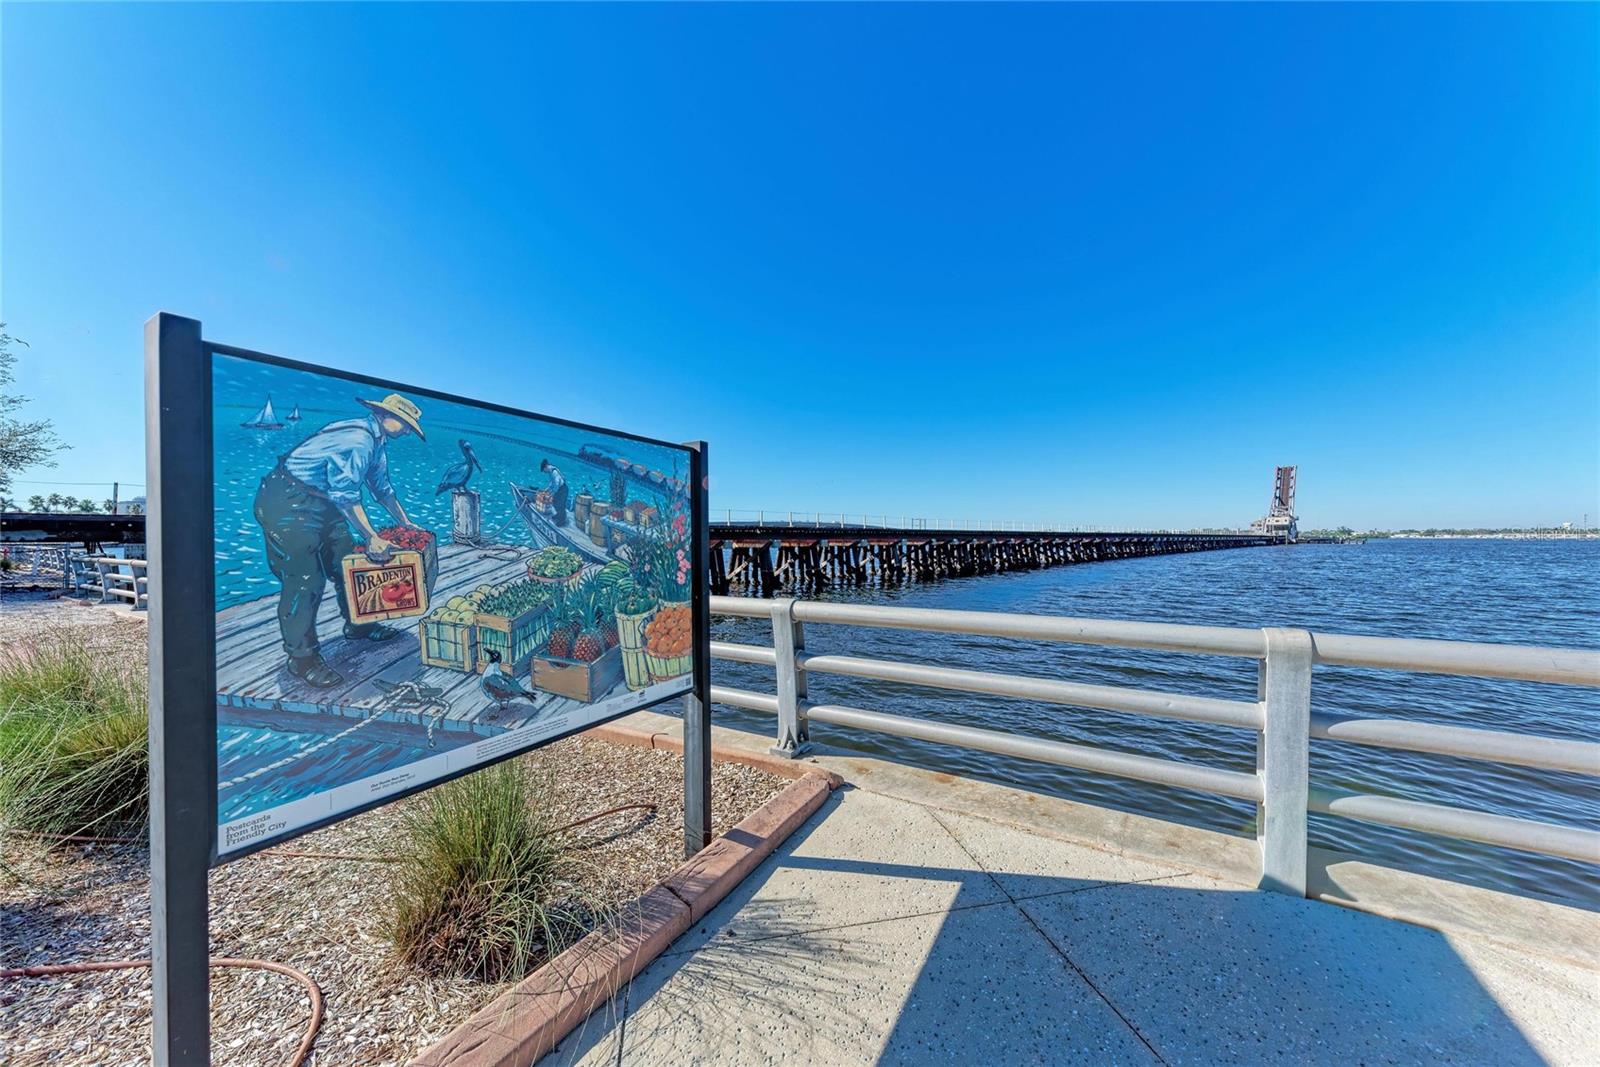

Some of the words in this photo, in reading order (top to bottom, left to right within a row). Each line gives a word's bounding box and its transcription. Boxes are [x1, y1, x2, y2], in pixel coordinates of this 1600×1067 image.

[226, 814, 271, 833] Postcards
[226, 828, 249, 840] from
[251, 822, 265, 832] the
[226, 828, 266, 846] Friendly
[268, 820, 287, 831] City
